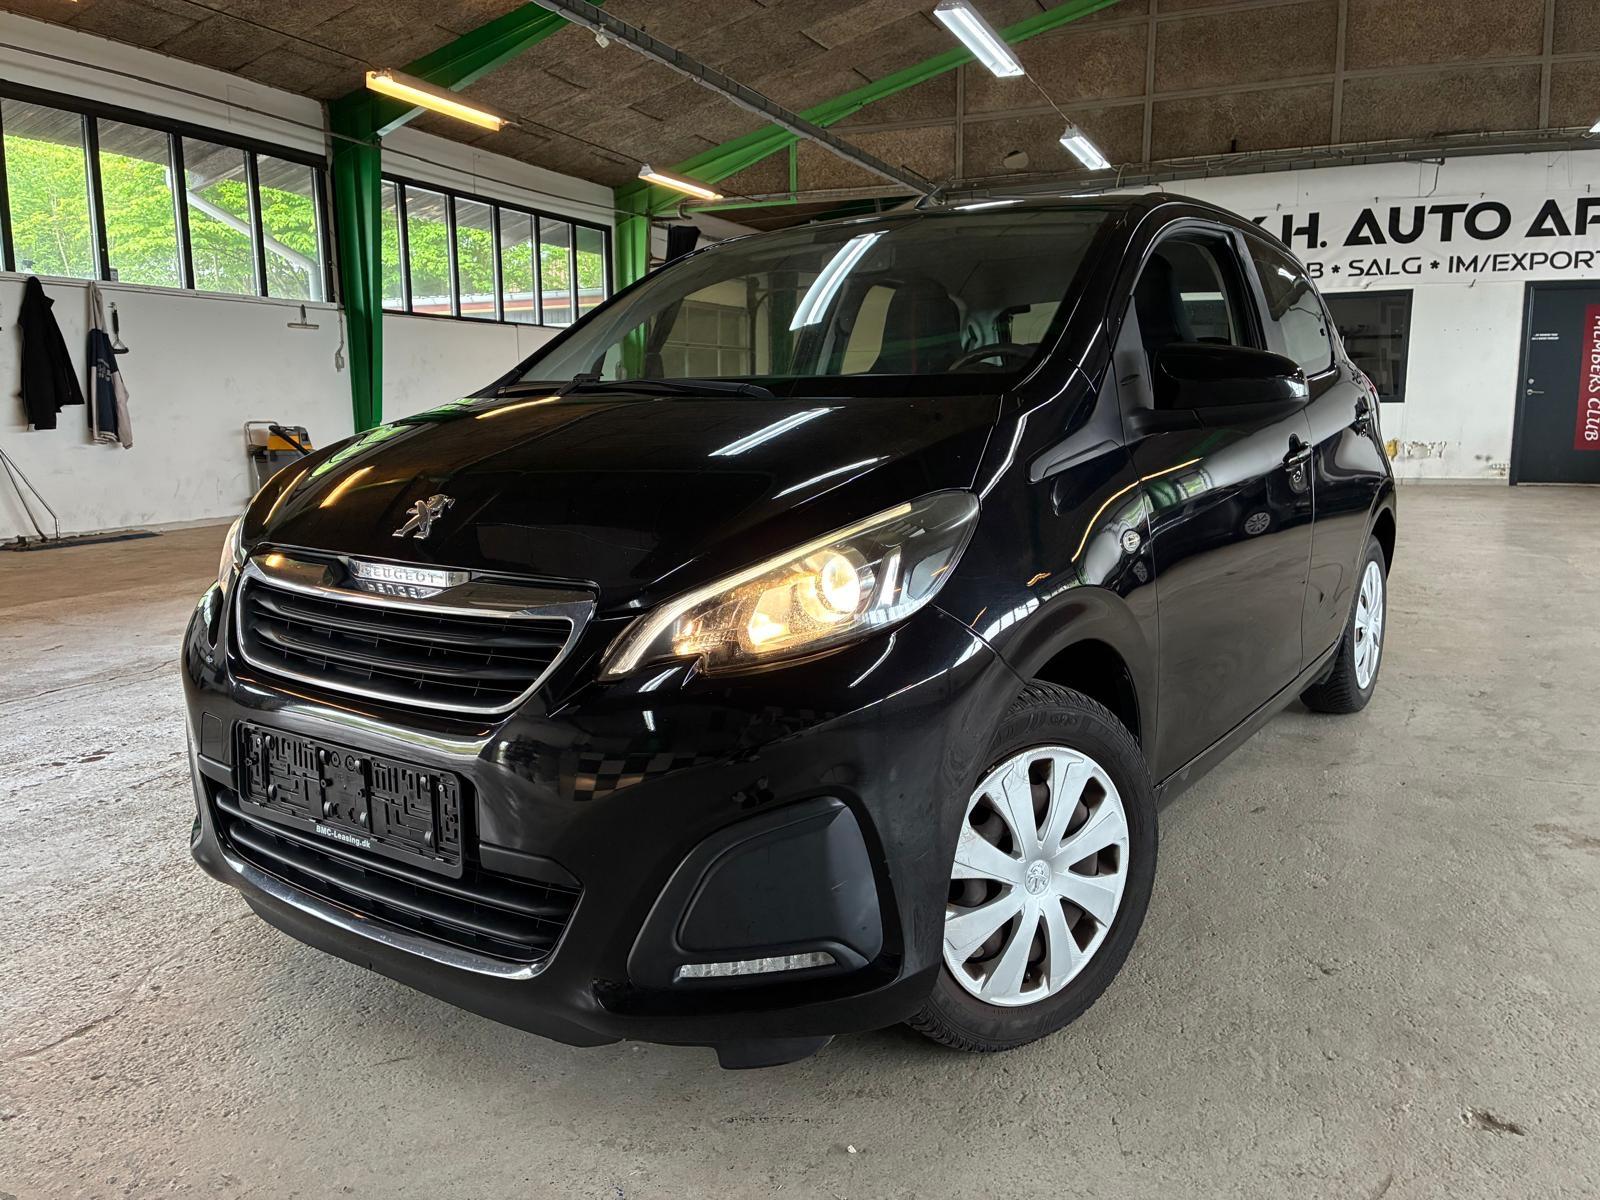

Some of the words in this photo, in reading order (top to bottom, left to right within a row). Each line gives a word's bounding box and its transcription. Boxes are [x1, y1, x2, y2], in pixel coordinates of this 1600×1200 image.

[1251, 212, 1328, 250] H.
[1342, 201, 1512, 247] AUTO
[1347, 257, 1422, 277] SALG
[1448, 250, 1600, 274] IM/EXPOR
[1584, 397, 1600, 442] CLUB
[360, 563, 443, 583] PEUGEOT
[316, 825, 371, 848] BMC-Leasing.dk
